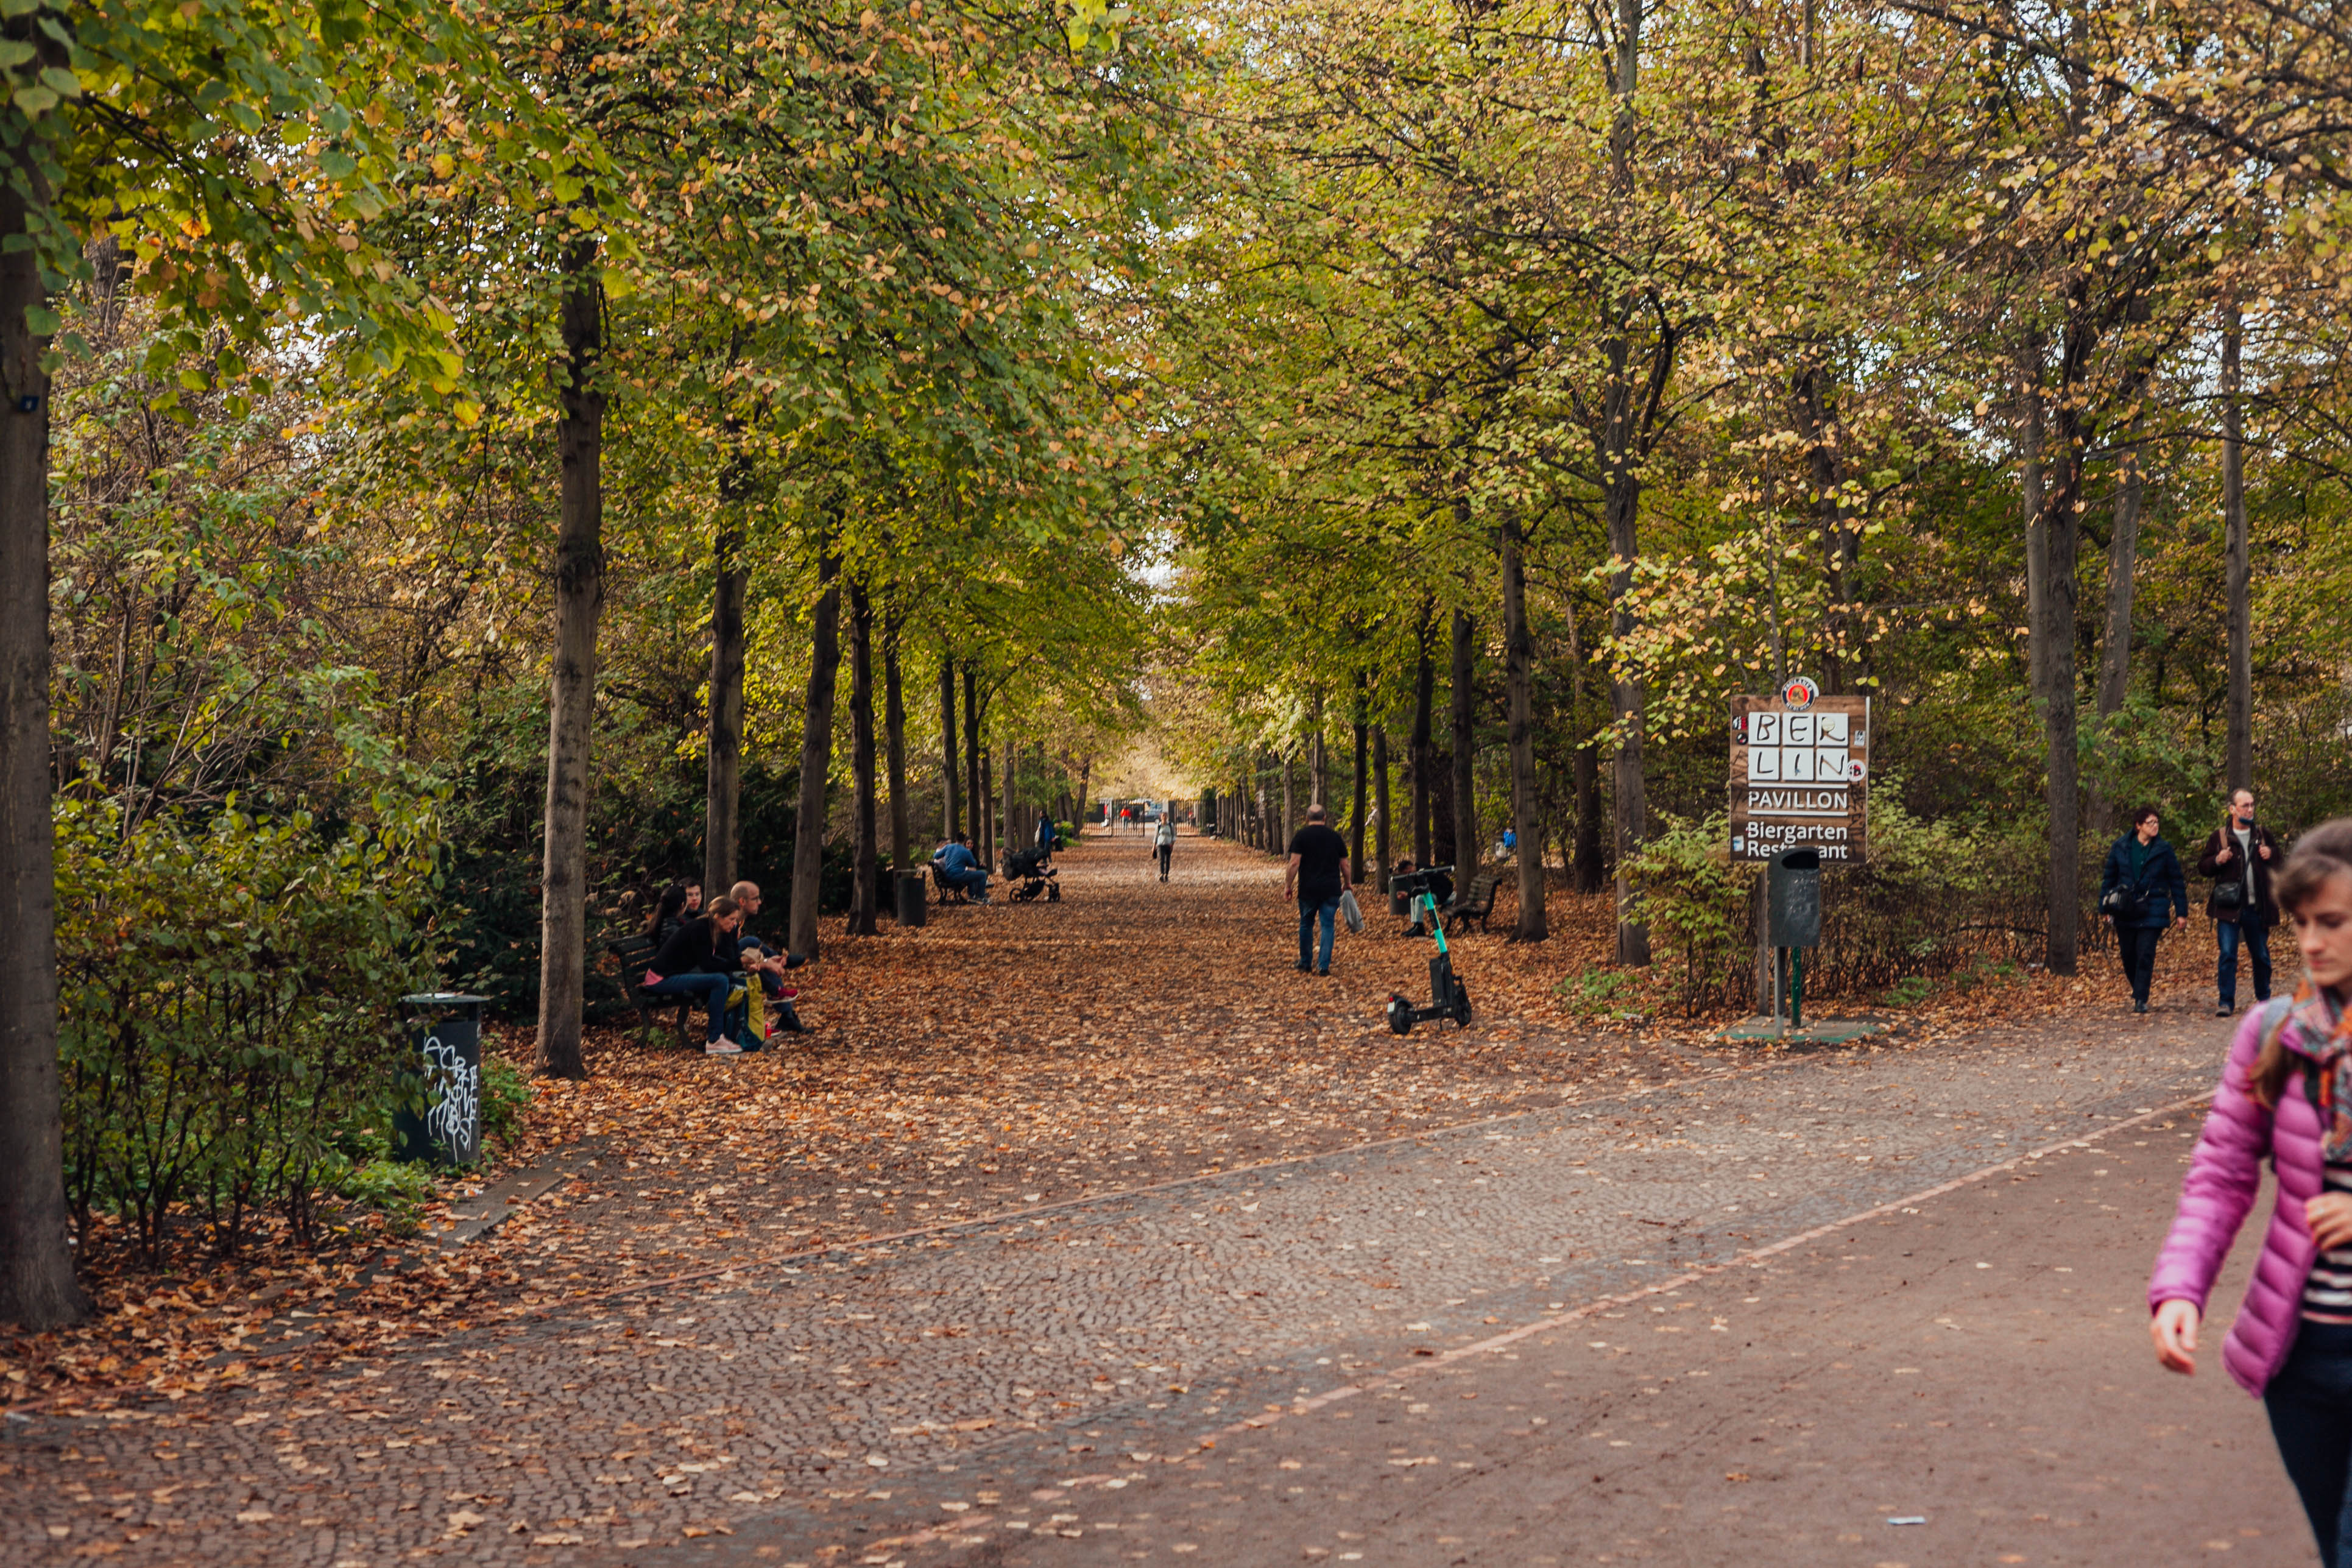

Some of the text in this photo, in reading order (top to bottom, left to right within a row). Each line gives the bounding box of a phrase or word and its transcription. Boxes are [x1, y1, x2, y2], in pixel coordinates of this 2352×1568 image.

[1748, 791, 1847, 809] PAVILLON
[1747, 821, 1848, 844] Biergarten
[1747, 840, 1848, 859] Restant
